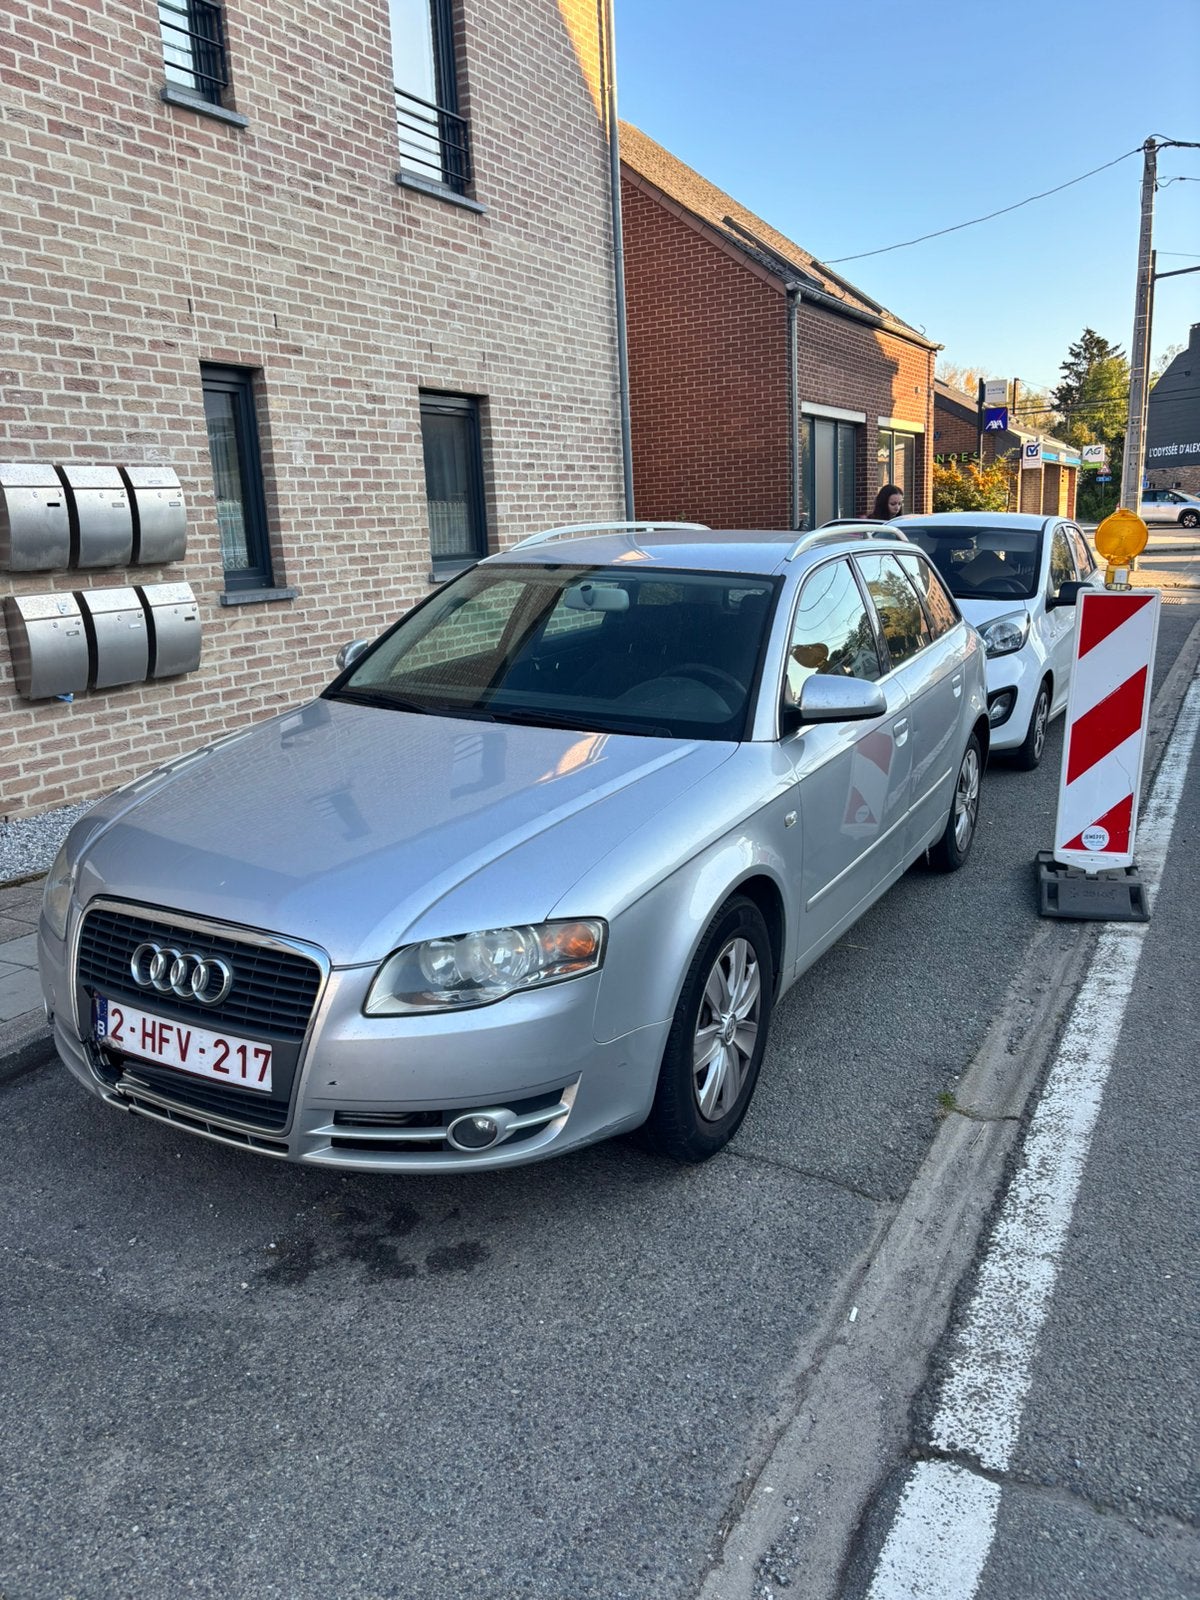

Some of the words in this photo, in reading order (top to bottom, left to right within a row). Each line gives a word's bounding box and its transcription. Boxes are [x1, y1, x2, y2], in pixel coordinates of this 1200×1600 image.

[985, 419, 1004, 430] AXA
[1084, 446, 1102, 457] AG
[1148, 442, 1178, 458] L'ODYSSÉE
[97, 1019, 106, 1036] B
